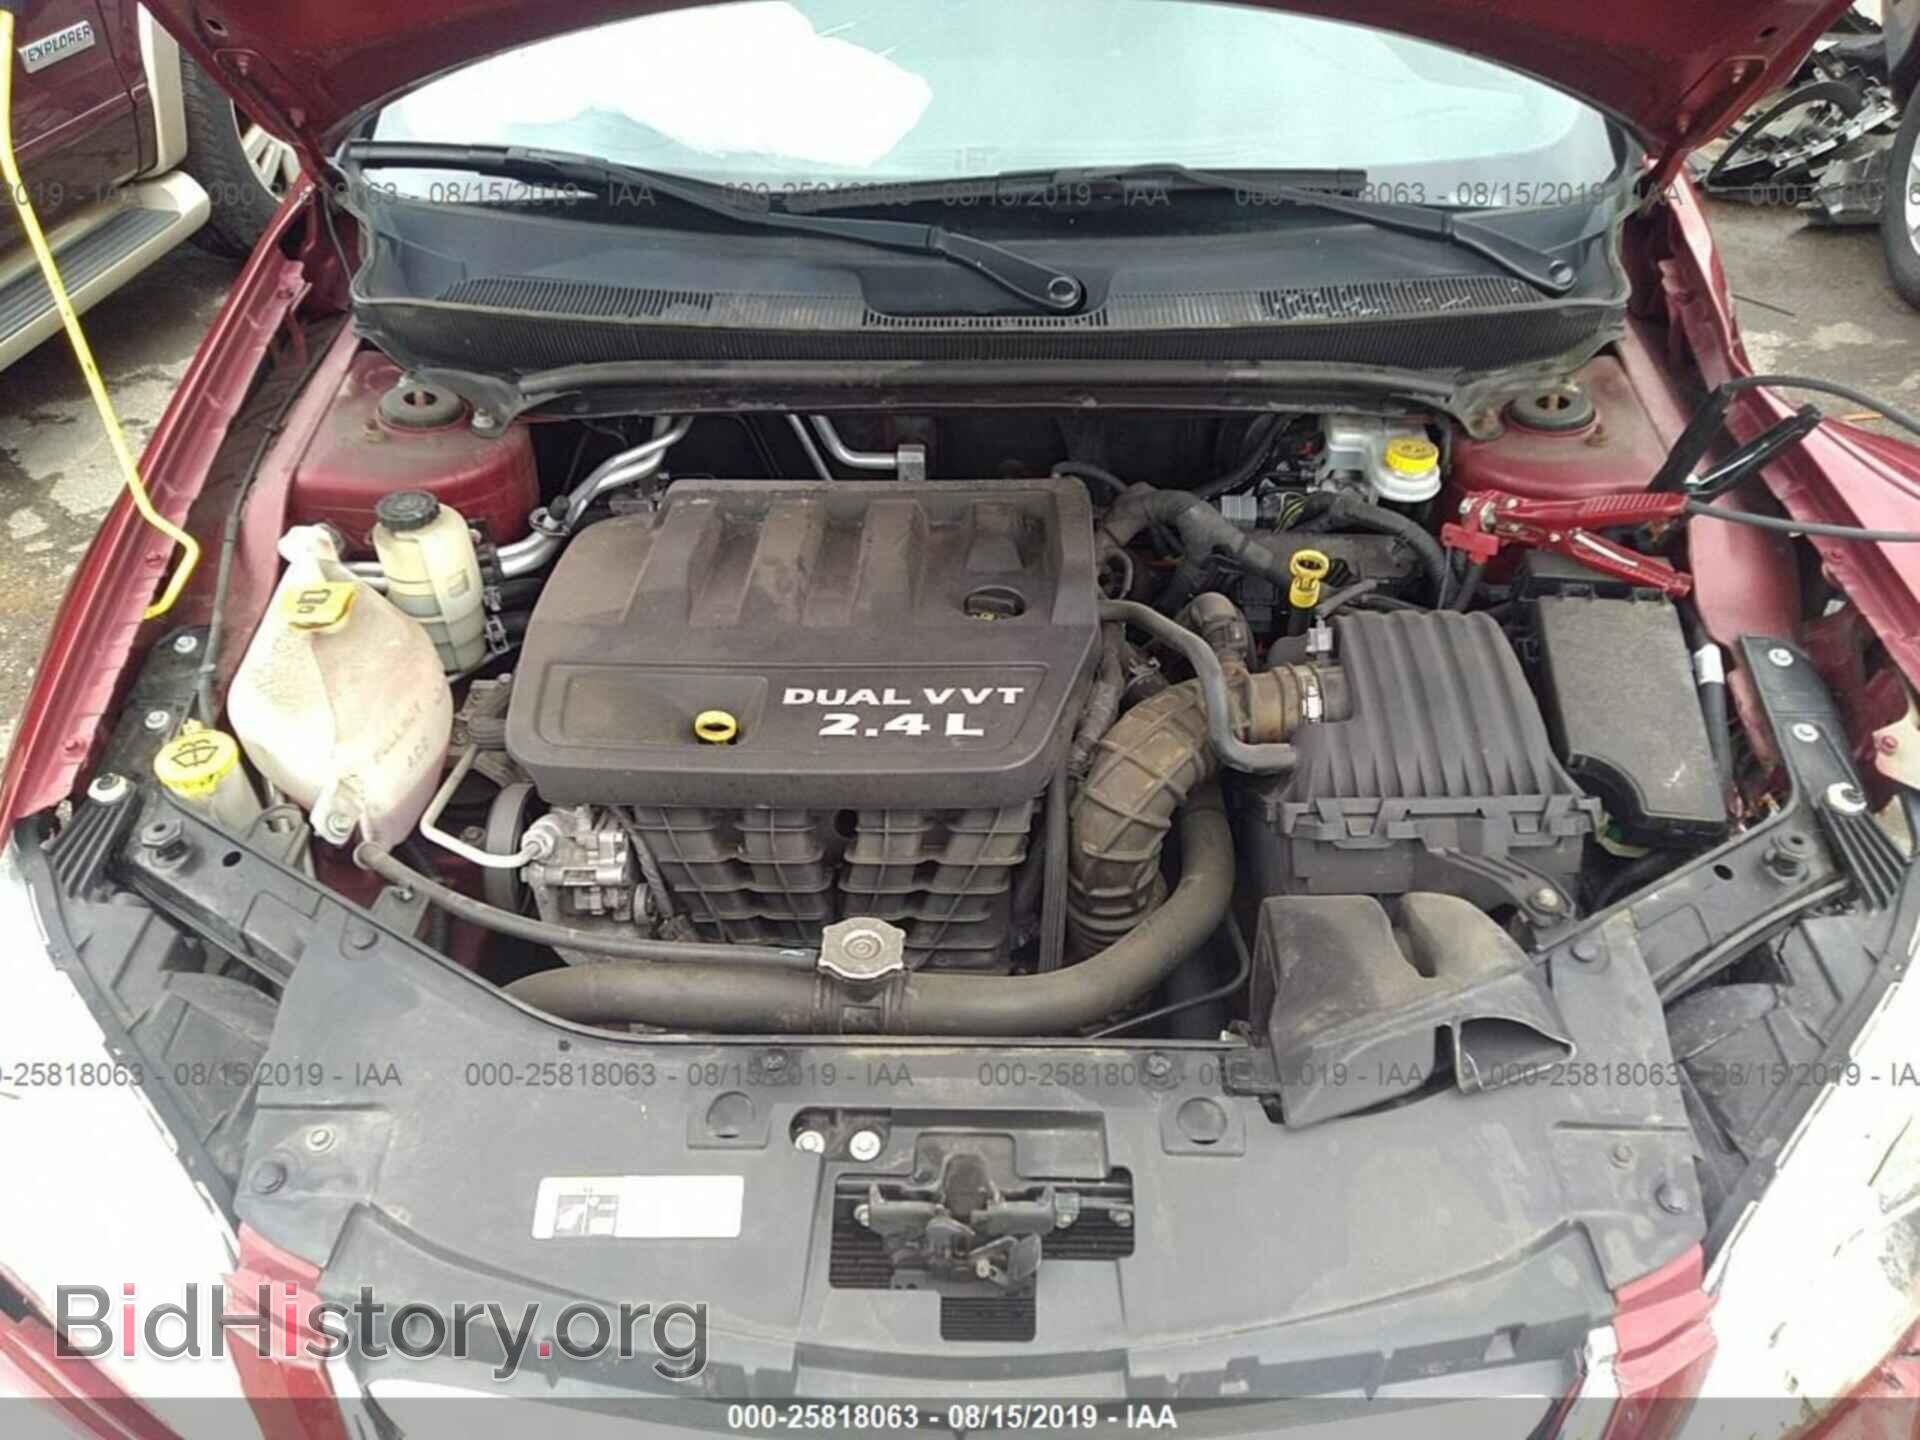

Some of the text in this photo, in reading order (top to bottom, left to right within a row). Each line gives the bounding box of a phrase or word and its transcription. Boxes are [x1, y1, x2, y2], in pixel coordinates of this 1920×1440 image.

[27, 25, 91, 62] EXPLORER
[782, 687, 1025, 705] DUAL VVT
